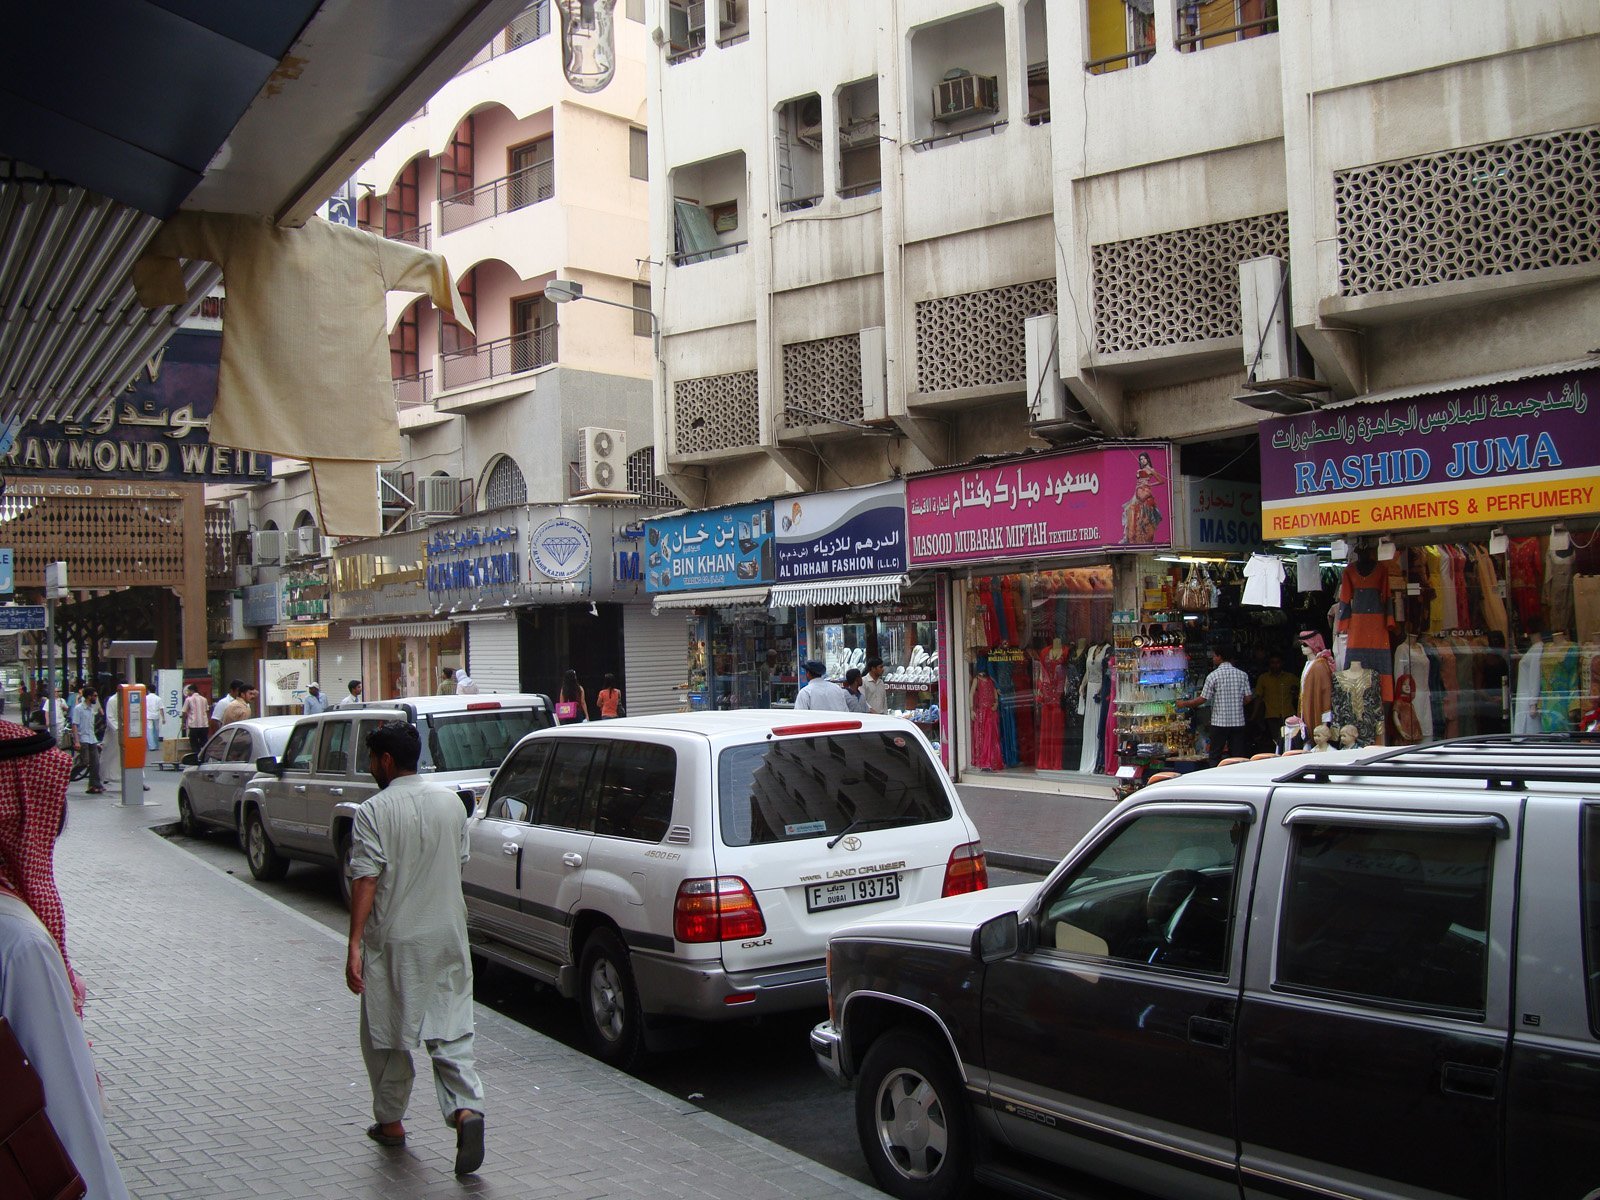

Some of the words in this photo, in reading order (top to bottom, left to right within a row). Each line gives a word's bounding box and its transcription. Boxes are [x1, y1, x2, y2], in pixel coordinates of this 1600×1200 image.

[1490, 393, 1543, 418] جمعة
[1541, 380, 1588, 414] راشد
[1358, 406, 1418, 442] الجاهزة
[1420, 394, 1487, 434] للملابس
[1272, 416, 1355, 451] والعطورات
[2, 437, 170, 473] RAYMOND
[179, 443, 267, 476] WEIL
[1294, 448, 1431, 494] RASHID
[1446, 431, 1562, 478] JUMA
[21, 485, 46, 495] CITY
[50, 486, 62, 495] OF
[952, 473, 992, 518] مفتاح
[993, 467, 1041, 510] مبارك
[1044, 470, 1099, 504] مسعود
[1273, 509, 1361, 530] READYMADE
[1371, 500, 1459, 523] GARMENTS
[1467, 498, 1479, 514] &
[1487, 487, 1594, 513] PERFUMERY
[671, 523, 710, 553] خان
[715, 525, 735, 548] بن
[813, 536, 850, 556] للازياء
[855, 530, 899, 553] الدرهم
[913, 532, 953, 557] MASOOD
[954, 526, 1004, 553] MUBARAK
[1005, 522, 1048, 548] MIFTAH
[1049, 529, 1078, 544] TEXTILE
[1079, 526, 1101, 541] TRDG.
[1200, 518, 1262, 545] MASOO
[673, 557, 694, 577] BIN
[698, 553, 735, 574] KHAN
[780, 565, 791, 577] AL
[793, 560, 829, 576] DIRHAM
[832, 556, 874, 573] FASHION
[645, 850, 666, 859] 4500
[666, 853, 681, 861] EFI
[826, 868, 857, 879] LAND
[858, 860, 906, 875] CRUISER
[814, 888, 822, 905] F
[828, 894, 847, 904] DUBAI
[852, 876, 894, 900] 19375
[741, 938, 773, 949] GXR
[1016, 1106, 1056, 1127] 2500
